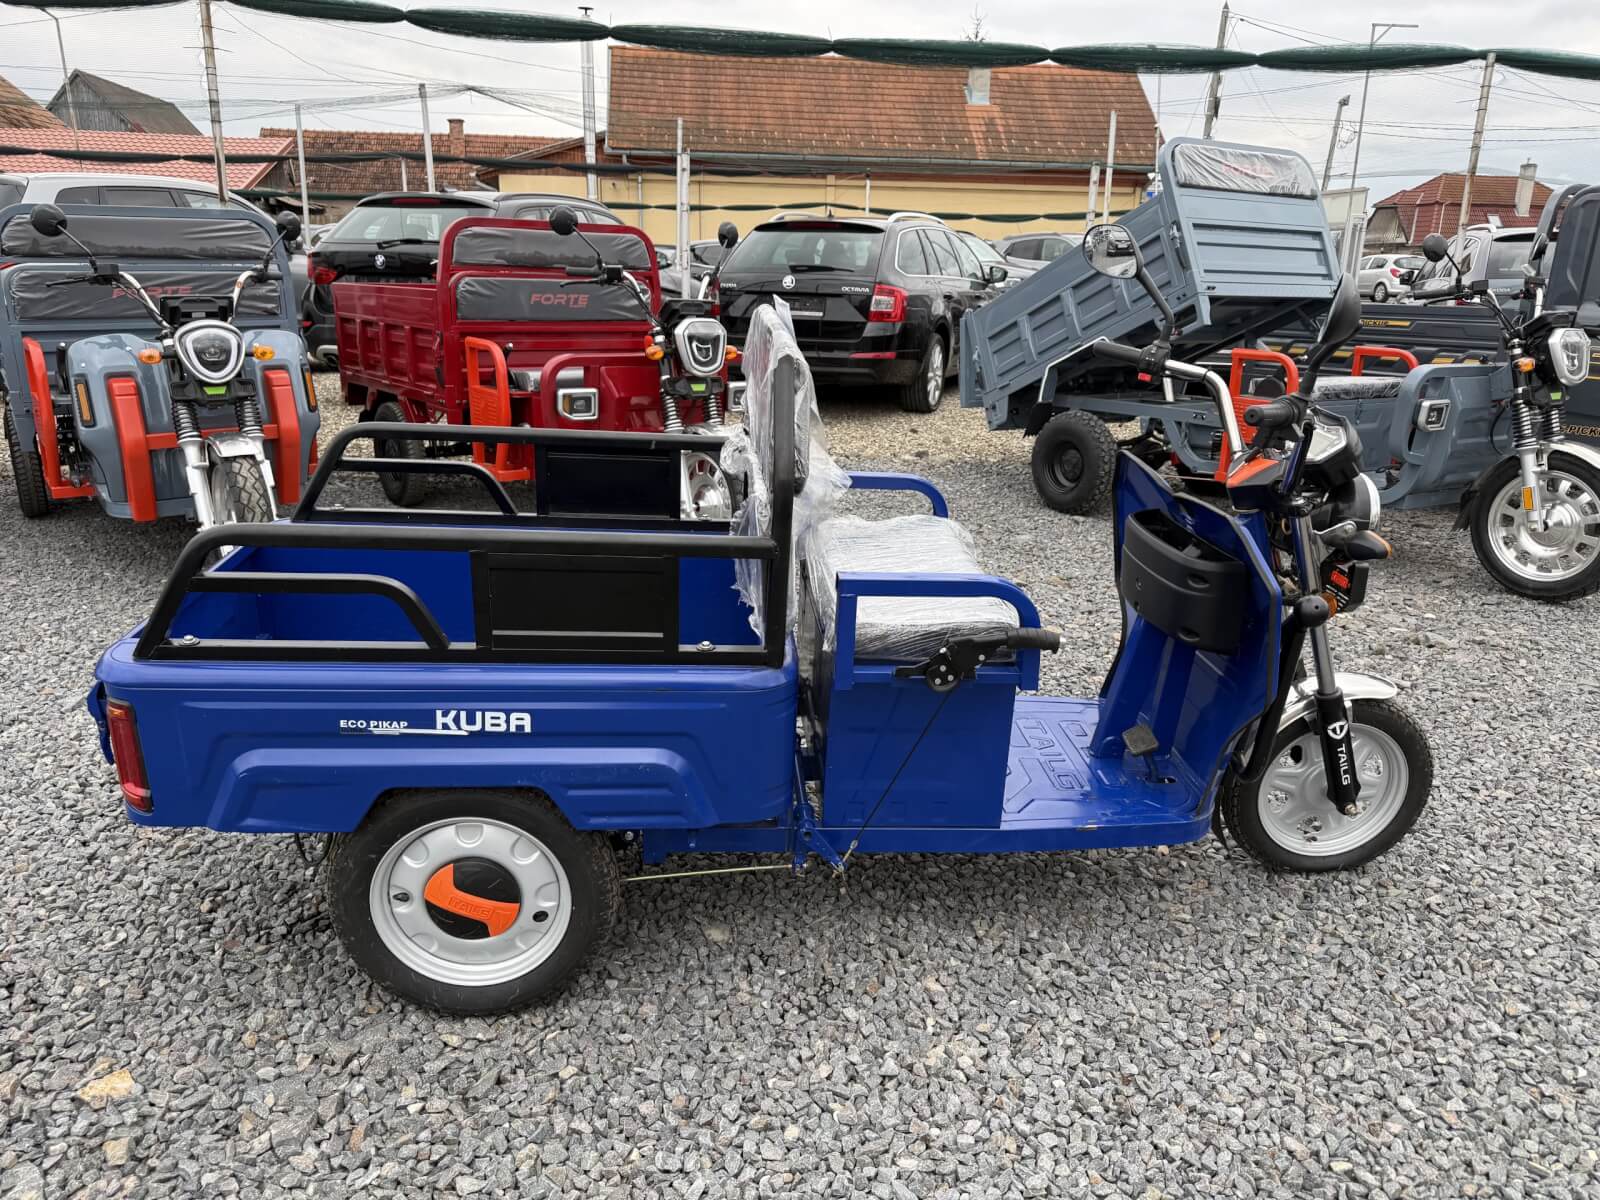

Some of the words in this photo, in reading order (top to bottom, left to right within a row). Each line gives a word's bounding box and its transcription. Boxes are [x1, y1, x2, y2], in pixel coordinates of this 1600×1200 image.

[530, 293, 590, 305] FORTE
[340, 720, 367, 728] ECO
[370, 720, 408, 729] PIKAP
[435, 709, 532, 733] KUBA
[1022, 718, 1085, 790] TAILG
[1337, 743, 1351, 785] TAILG
